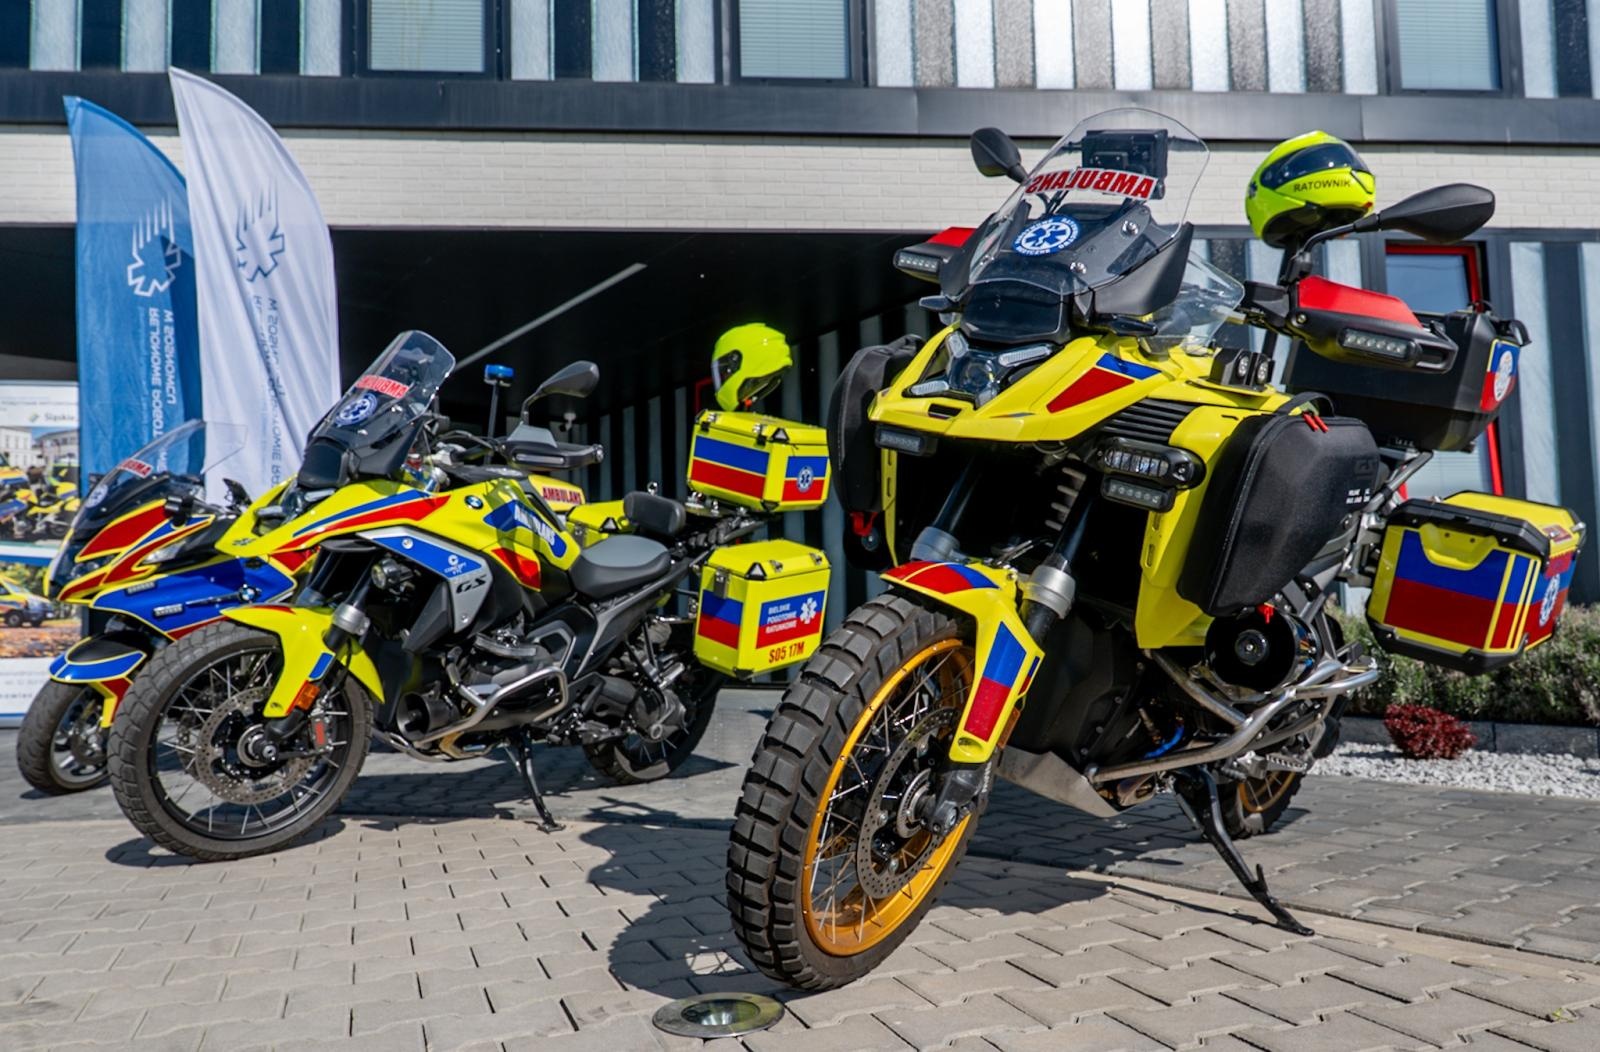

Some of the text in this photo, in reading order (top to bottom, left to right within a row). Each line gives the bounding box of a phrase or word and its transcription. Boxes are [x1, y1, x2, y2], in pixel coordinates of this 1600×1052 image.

[1293, 179, 1351, 192] RATOWNIK
[456, 573, 487, 594] GS
[768, 641, 805, 663] S05 17M
